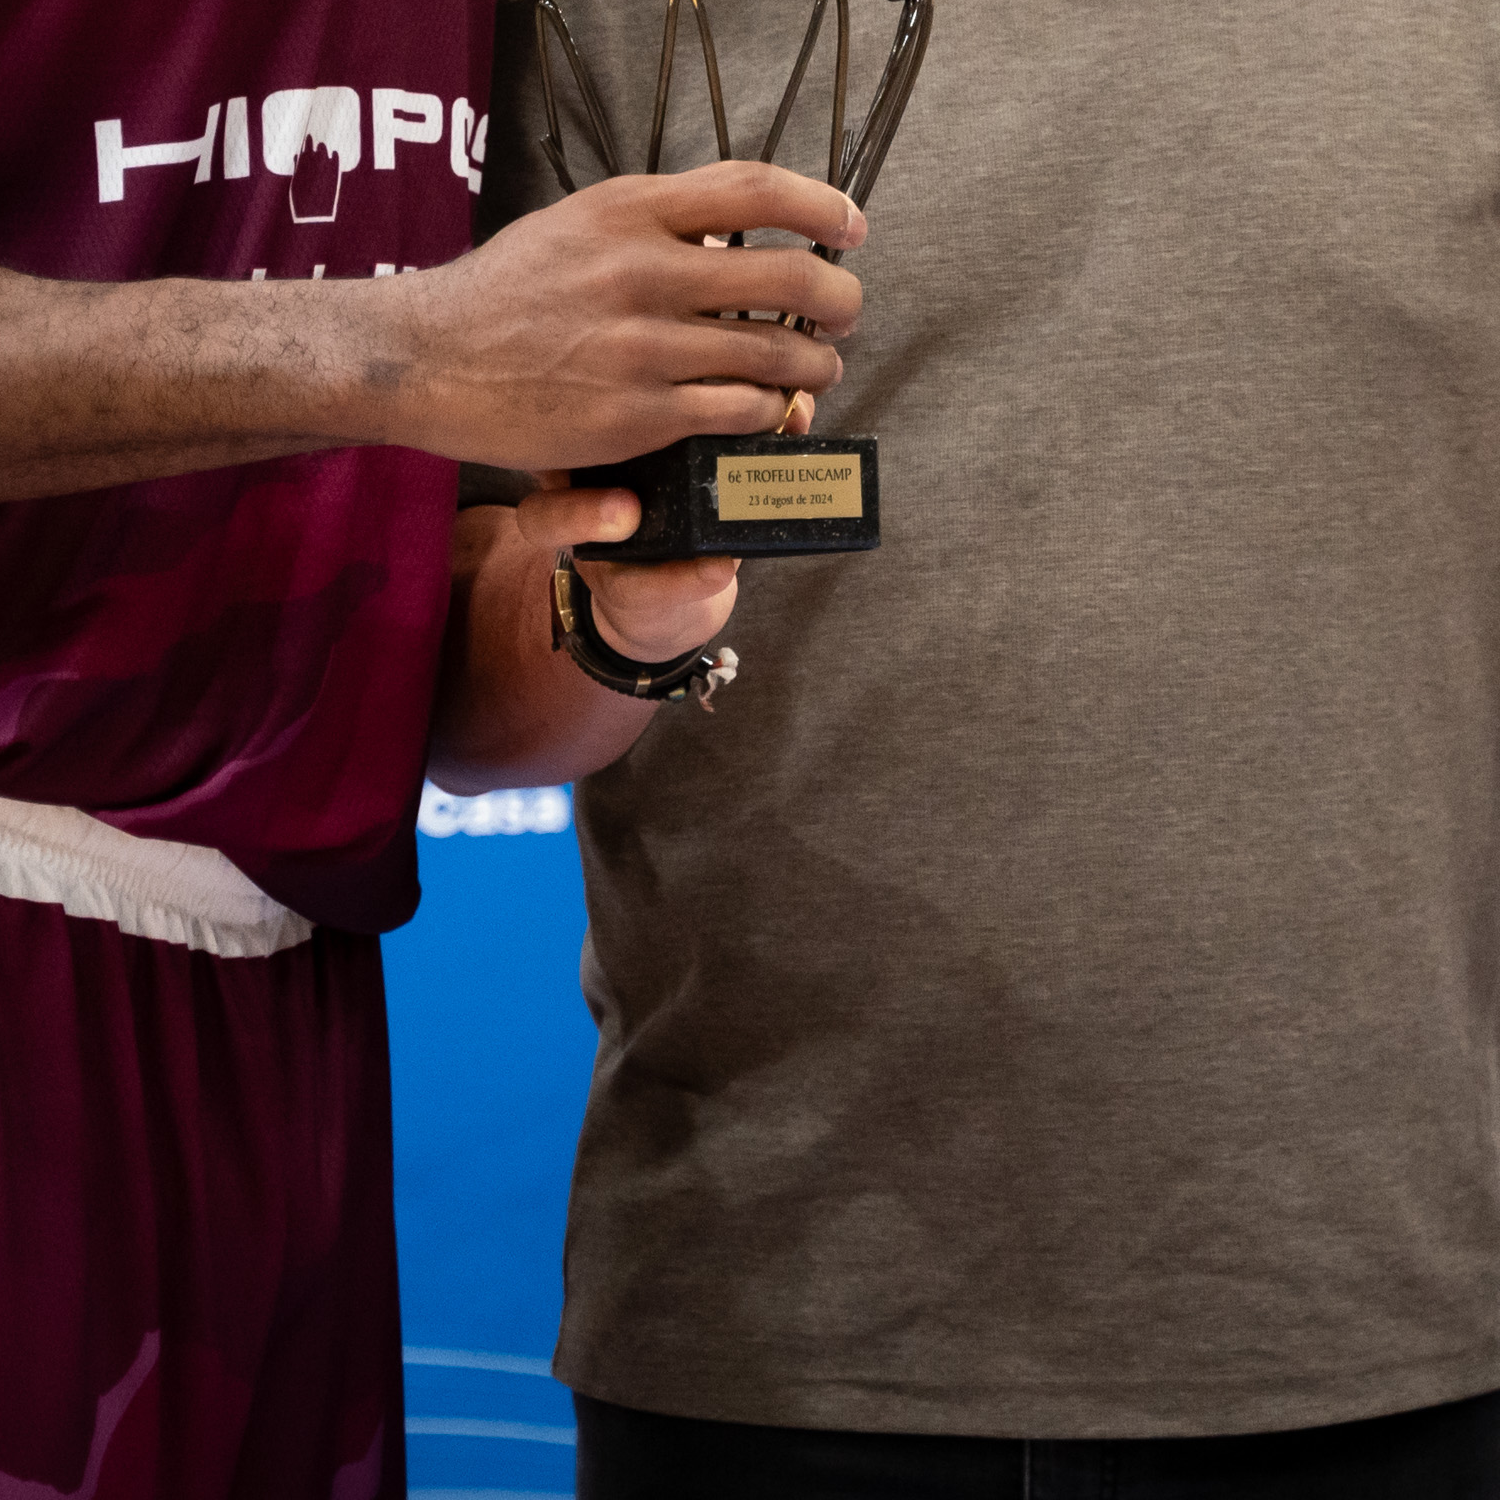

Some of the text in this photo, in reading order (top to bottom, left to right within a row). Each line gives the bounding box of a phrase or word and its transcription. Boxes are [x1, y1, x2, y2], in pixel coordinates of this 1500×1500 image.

[746, 469, 795, 483] TROFEU
[798, 468, 852, 481] ENCAMP
[748, 493, 833, 508] 23 d'agost de 2024
